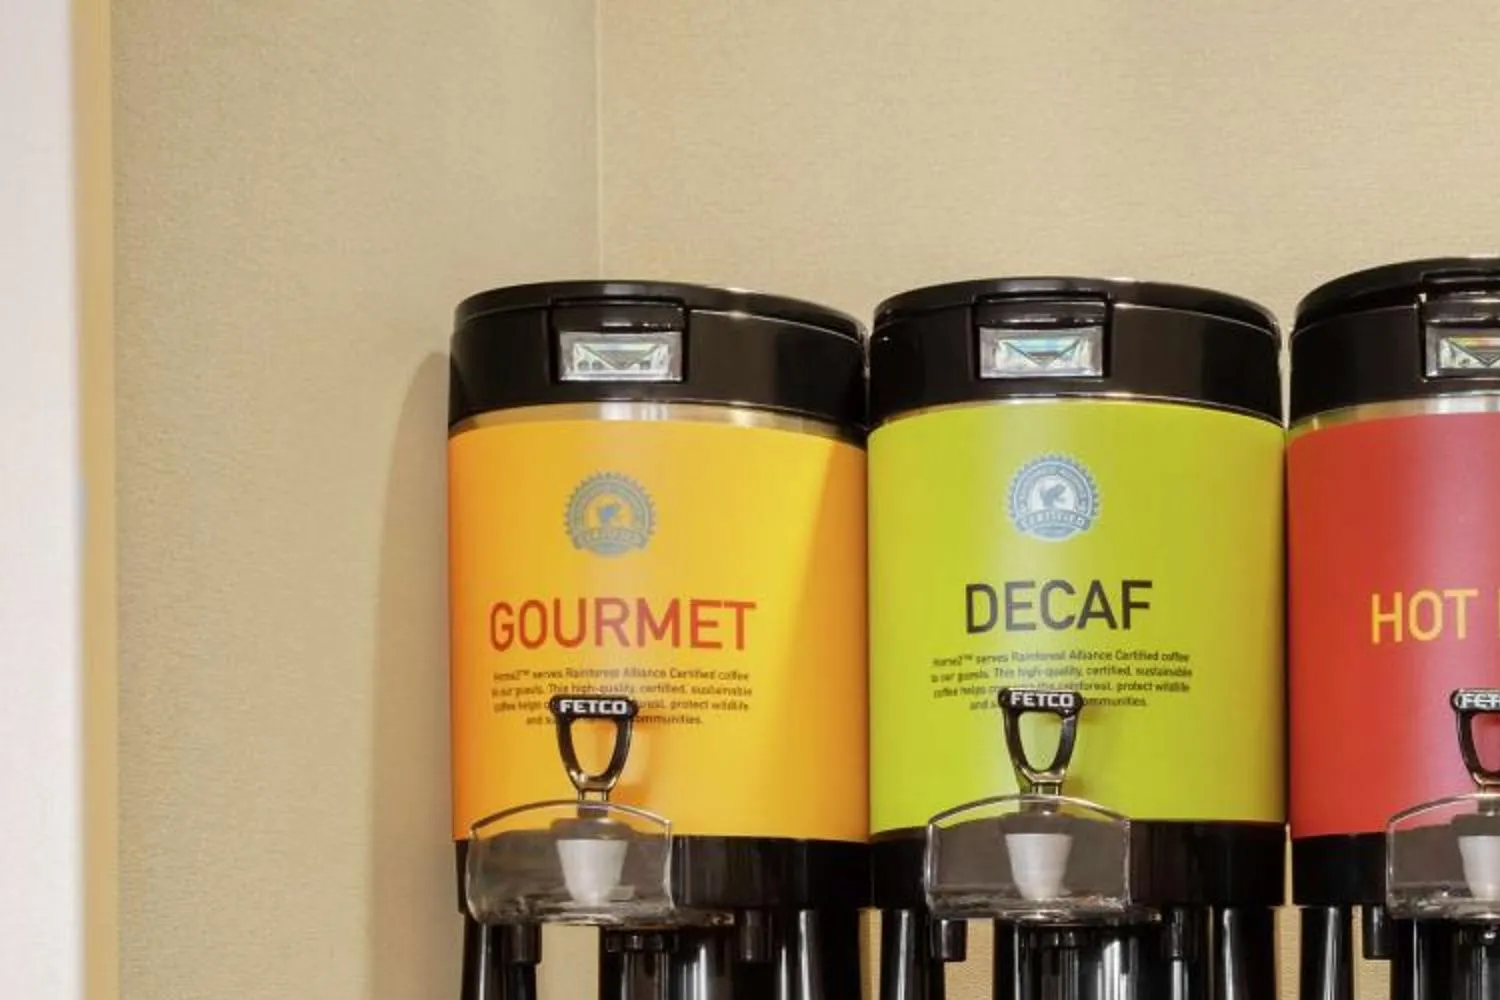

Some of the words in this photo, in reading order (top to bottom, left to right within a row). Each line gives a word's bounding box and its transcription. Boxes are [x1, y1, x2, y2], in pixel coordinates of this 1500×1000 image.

[489, 598, 757, 652] GOURMET
[965, 580, 1153, 634] DECAF
[1371, 588, 1479, 643] HOT
[559, 699, 627, 715] FETCO
[1011, 692, 1074, 707] FETCO
